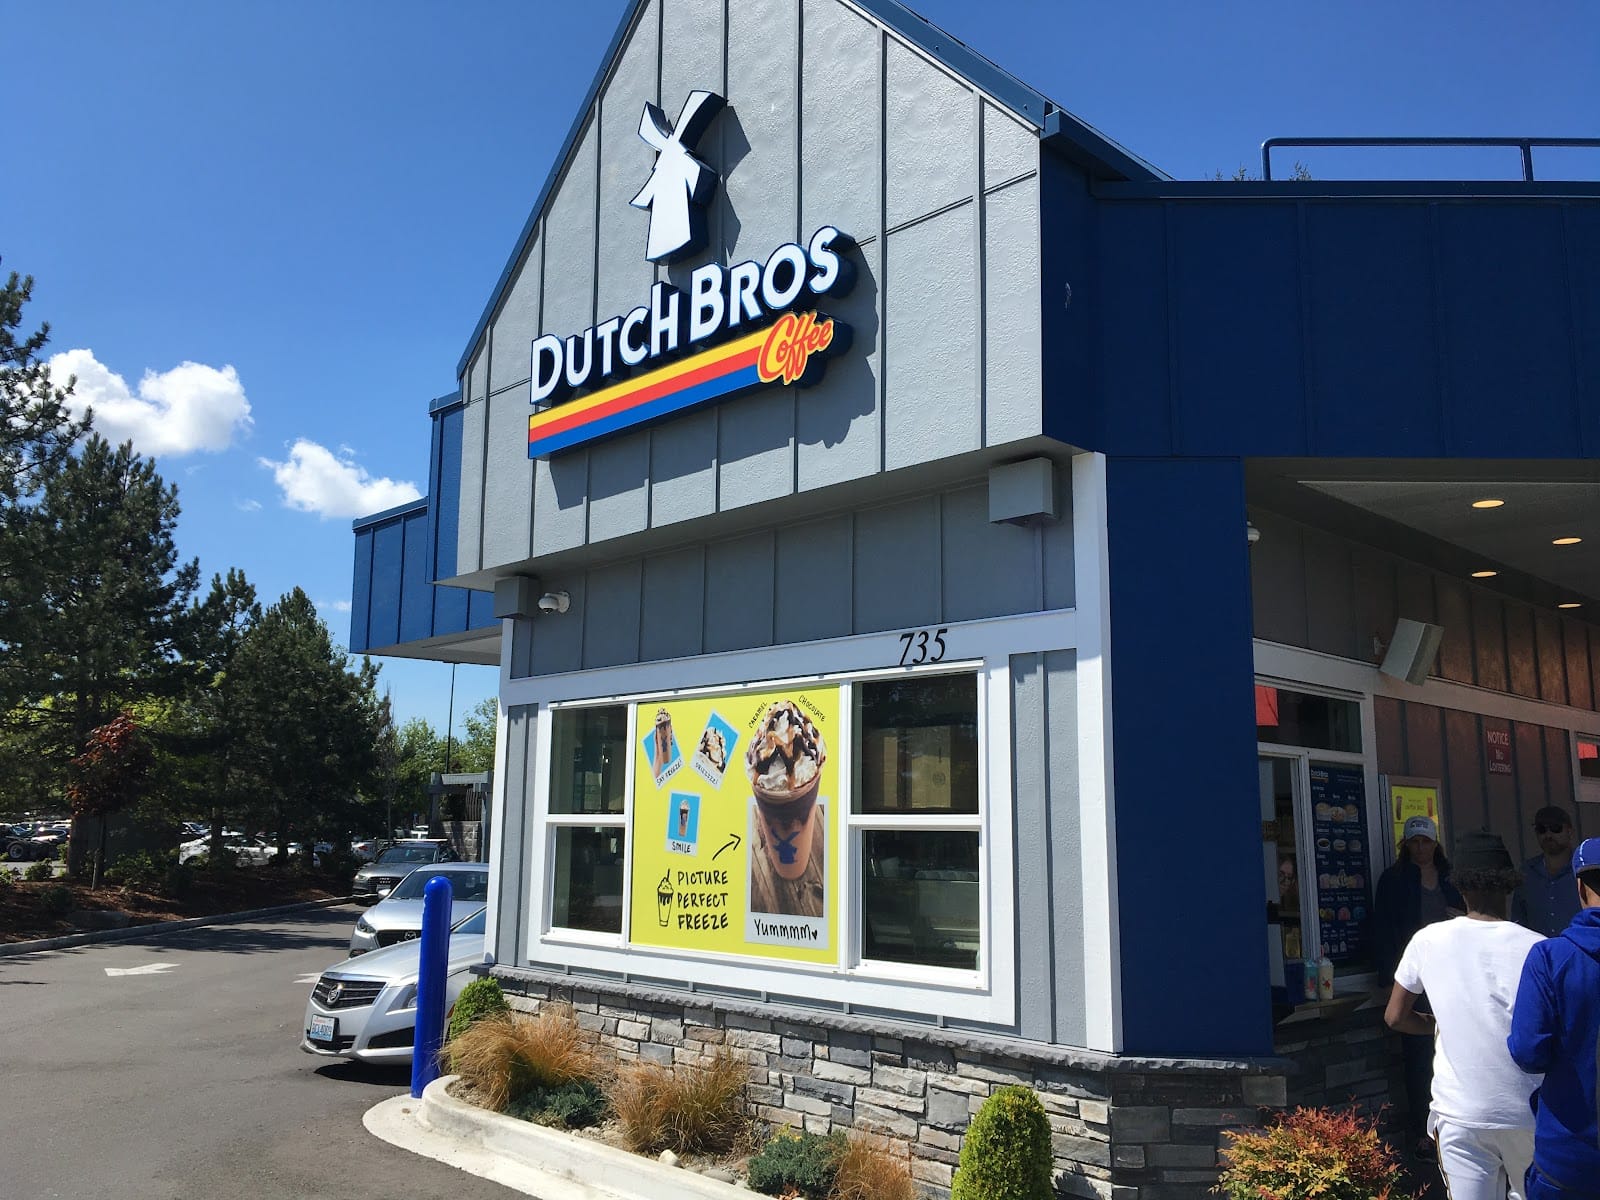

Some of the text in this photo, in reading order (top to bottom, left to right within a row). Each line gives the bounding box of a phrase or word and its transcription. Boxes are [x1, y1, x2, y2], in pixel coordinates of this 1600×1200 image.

[530, 225, 840, 405] DUTCH BROS
[758, 311, 833, 384] Coffee
[899, 628, 948, 667] 735
[748, 701, 768, 729] CARAMEL
[798, 694, 826, 723] CHOCOLATE
[1487, 731, 1509, 746] NOTICE
[671, 840, 691, 854] SMILE
[677, 870, 729, 885] PICTURE
[677, 892, 729, 909] PERFECT
[677, 913, 729, 930] FREEZE
